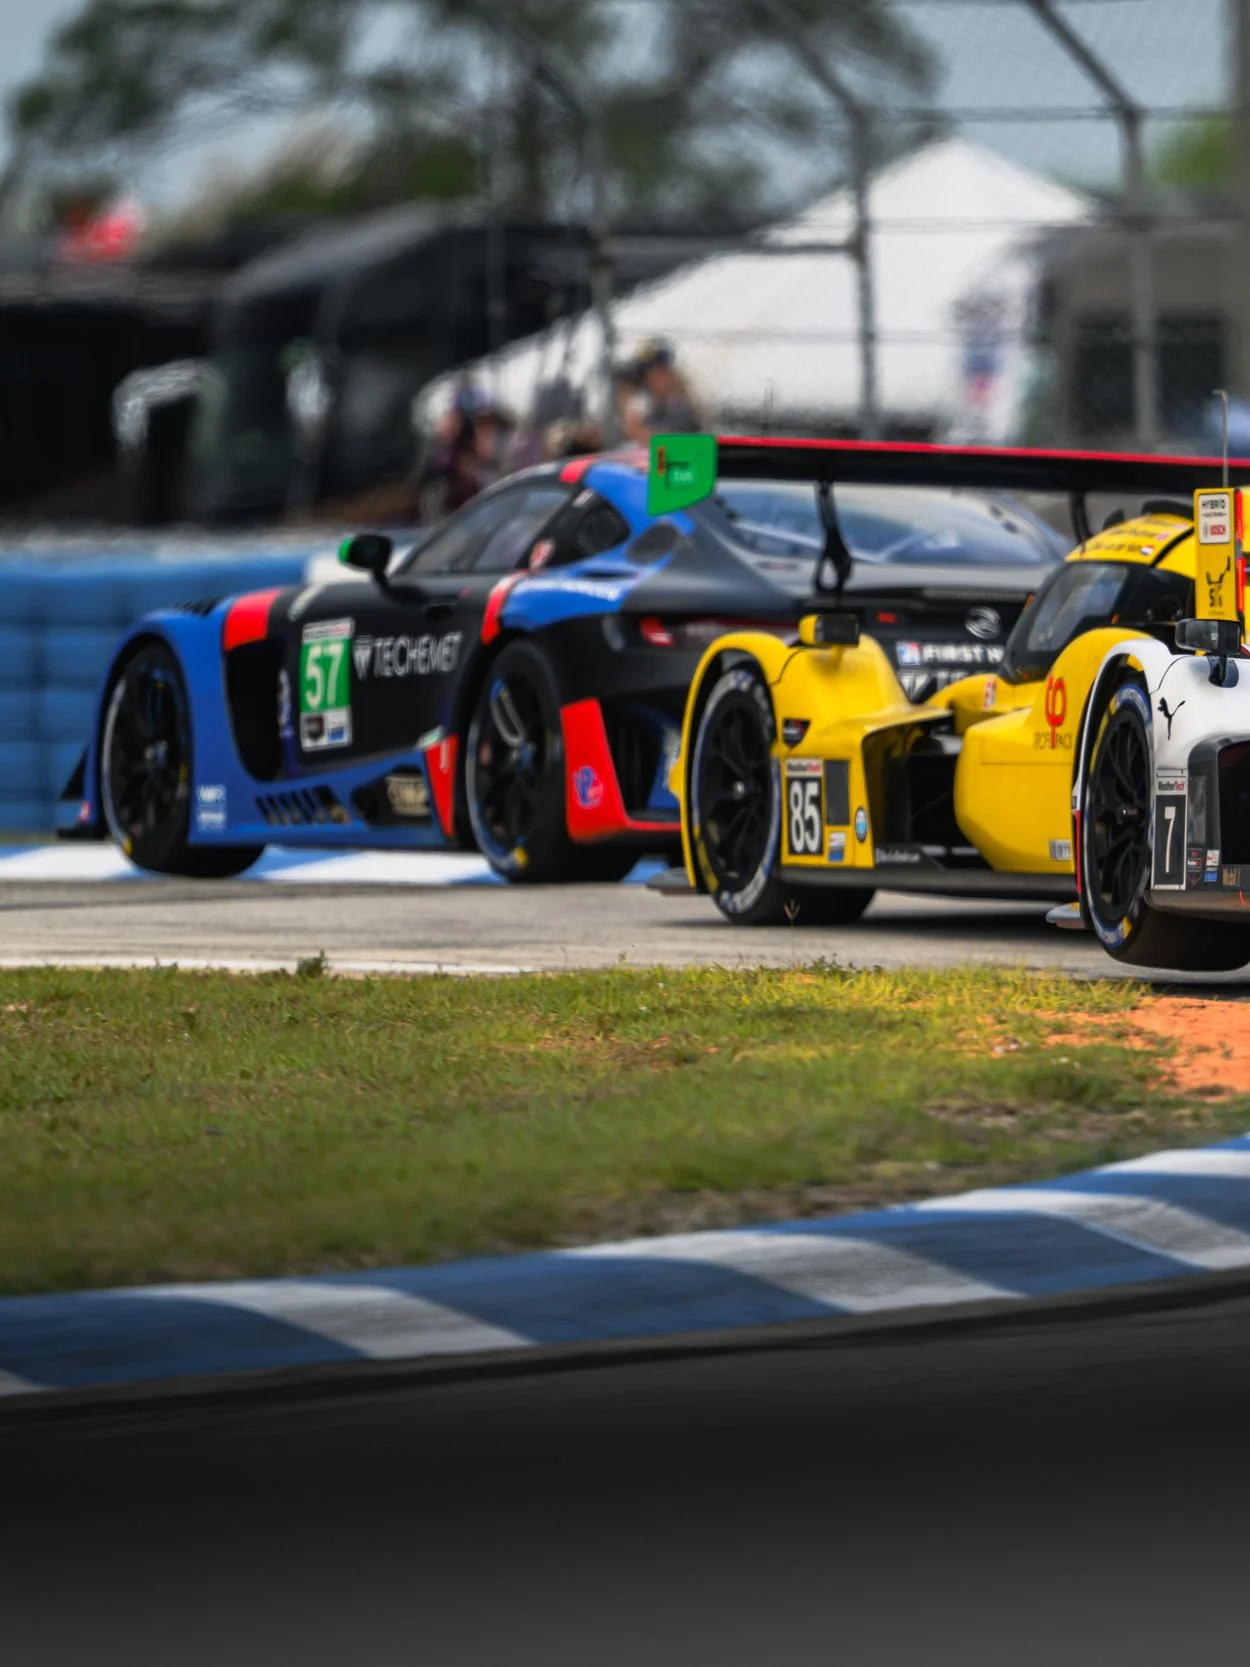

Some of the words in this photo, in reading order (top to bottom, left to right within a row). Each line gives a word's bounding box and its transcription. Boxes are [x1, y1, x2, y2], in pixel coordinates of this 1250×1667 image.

[1201, 499, 1226, 510] HYBRID
[305, 641, 344, 710] 57
[374, 632, 462, 677] TECHEMET
[922, 643, 983, 664] FIRST
[790, 781, 821, 853] 85
[1164, 806, 1176, 873] 7
